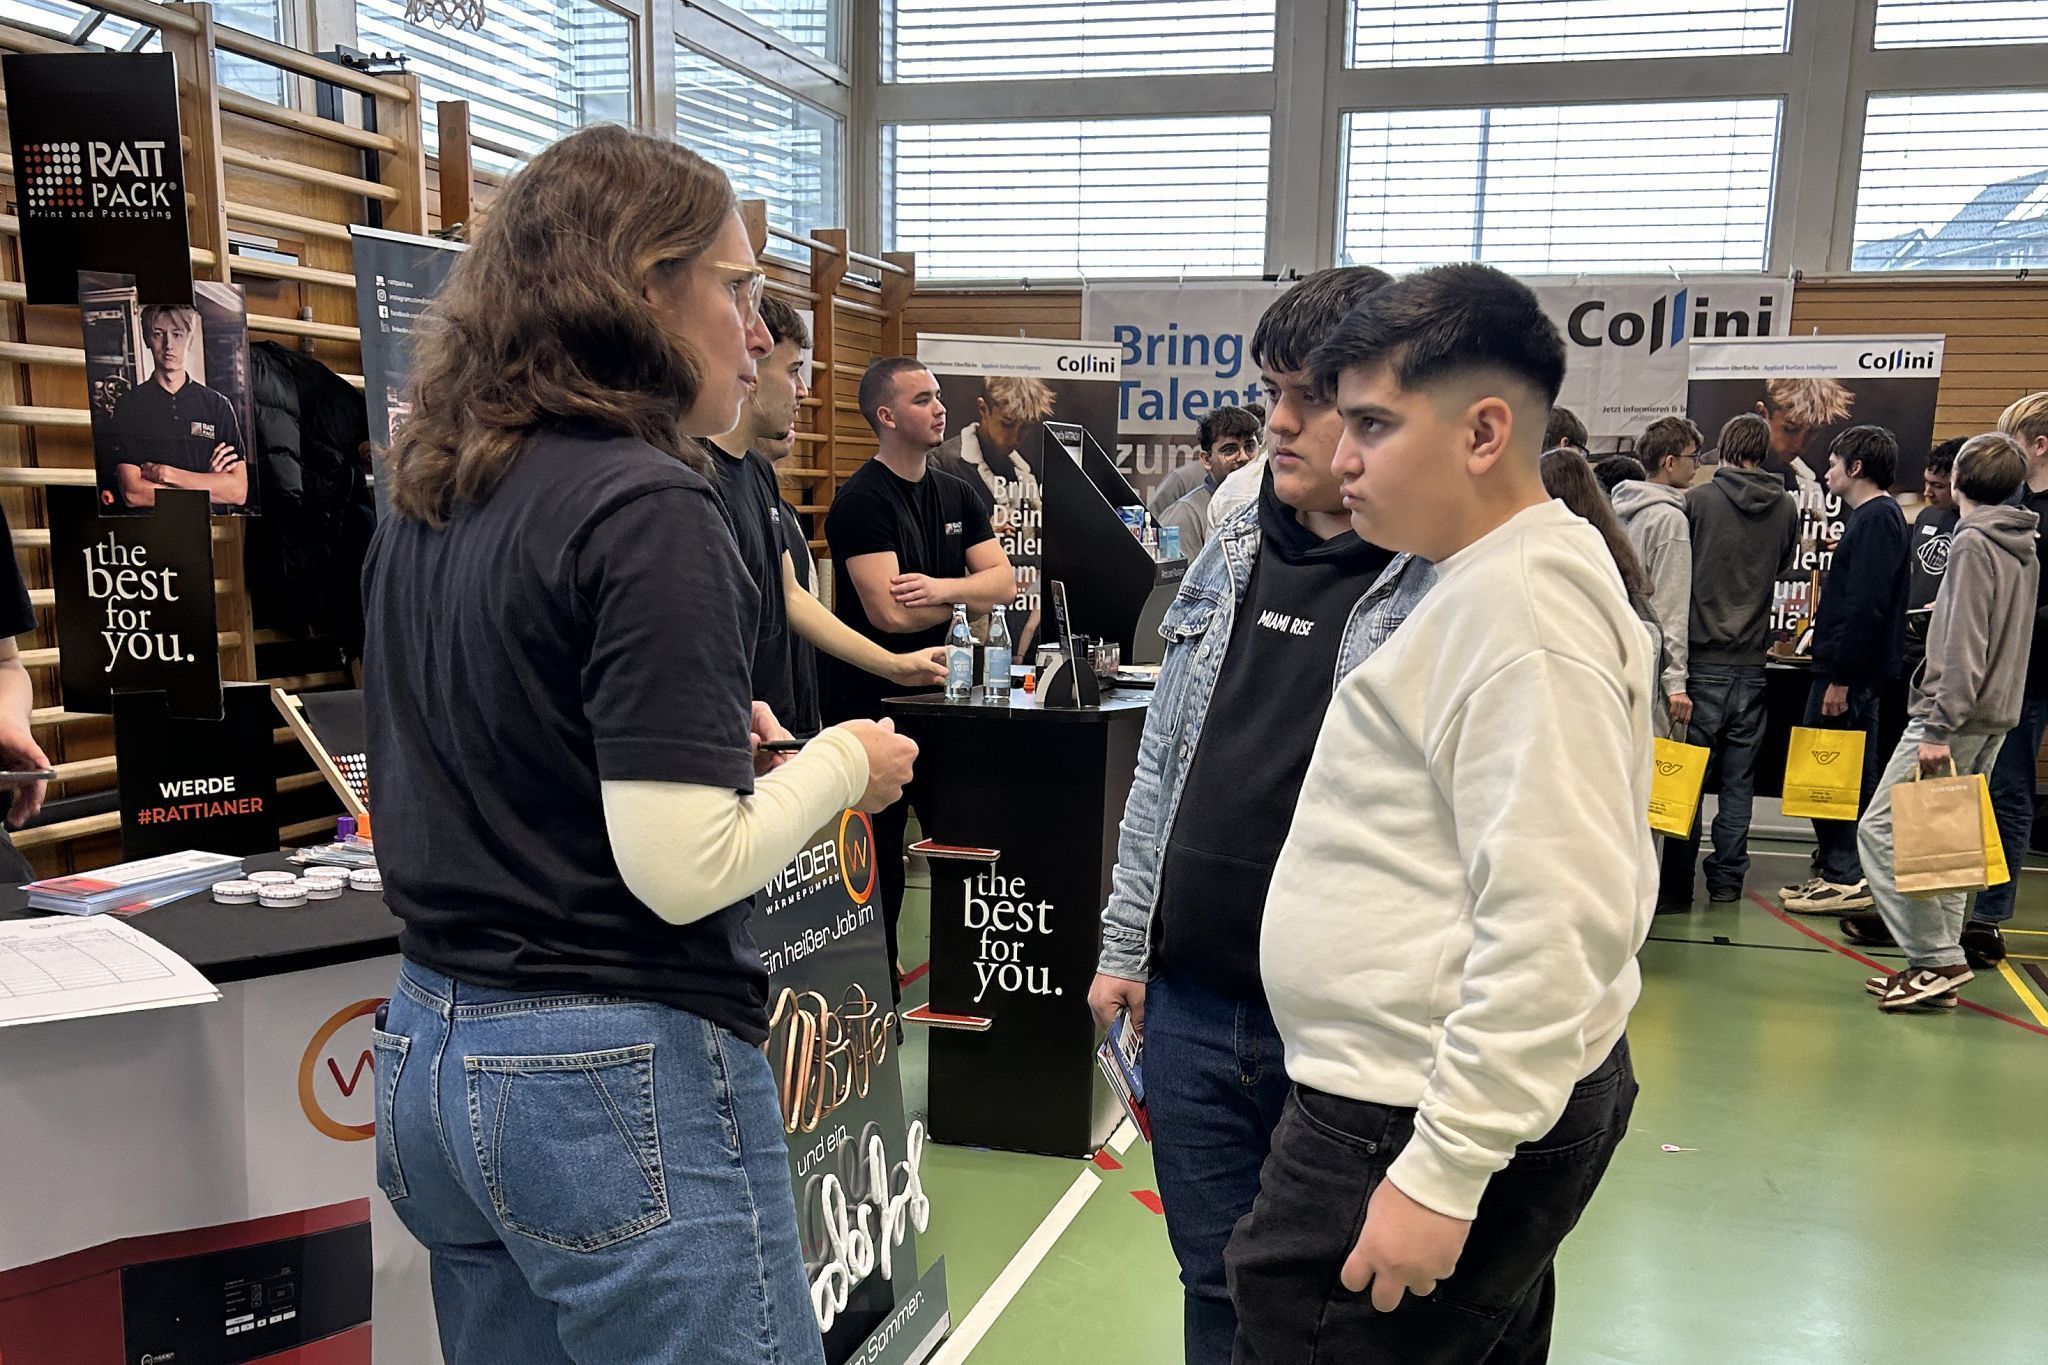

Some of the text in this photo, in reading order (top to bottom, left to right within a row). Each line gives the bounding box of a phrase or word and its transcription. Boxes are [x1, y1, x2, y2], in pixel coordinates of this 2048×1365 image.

[88, 141, 165, 177] RATT
[29, 209, 172, 220] Print and Packaging
[1568, 288, 1773, 356] Collini
[1056, 353, 1115, 374] Collini
[1113, 323, 1243, 378] Bring
[1858, 348, 1934, 372] Collini
[1602, 405, 1621, 413] Jetzt
[1623, 405, 1669, 413] informieren
[993, 475, 1043, 499] Brin
[96, 531, 147, 566] the
[83, 547, 179, 601] best
[106, 595, 151, 630] for
[1257, 609, 1315, 636] MIAMI RISE
[101, 631, 195, 673] you.
[159, 776, 236, 798] WERDE
[138, 797, 263, 825] #RATTIANER
[765, 839, 837, 897] WEIDER
[977, 862, 1026, 898] the
[963, 877, 1054, 934] best
[783, 928, 831, 967] heißer
[832, 909, 857, 941] Job
[857, 904, 874, 926] im
[979, 926, 1025, 962] for
[973, 962, 1063, 1003] you.
[797, 1124, 848, 1176] und ein
[867, 1290, 925, 1363] Sommer.
